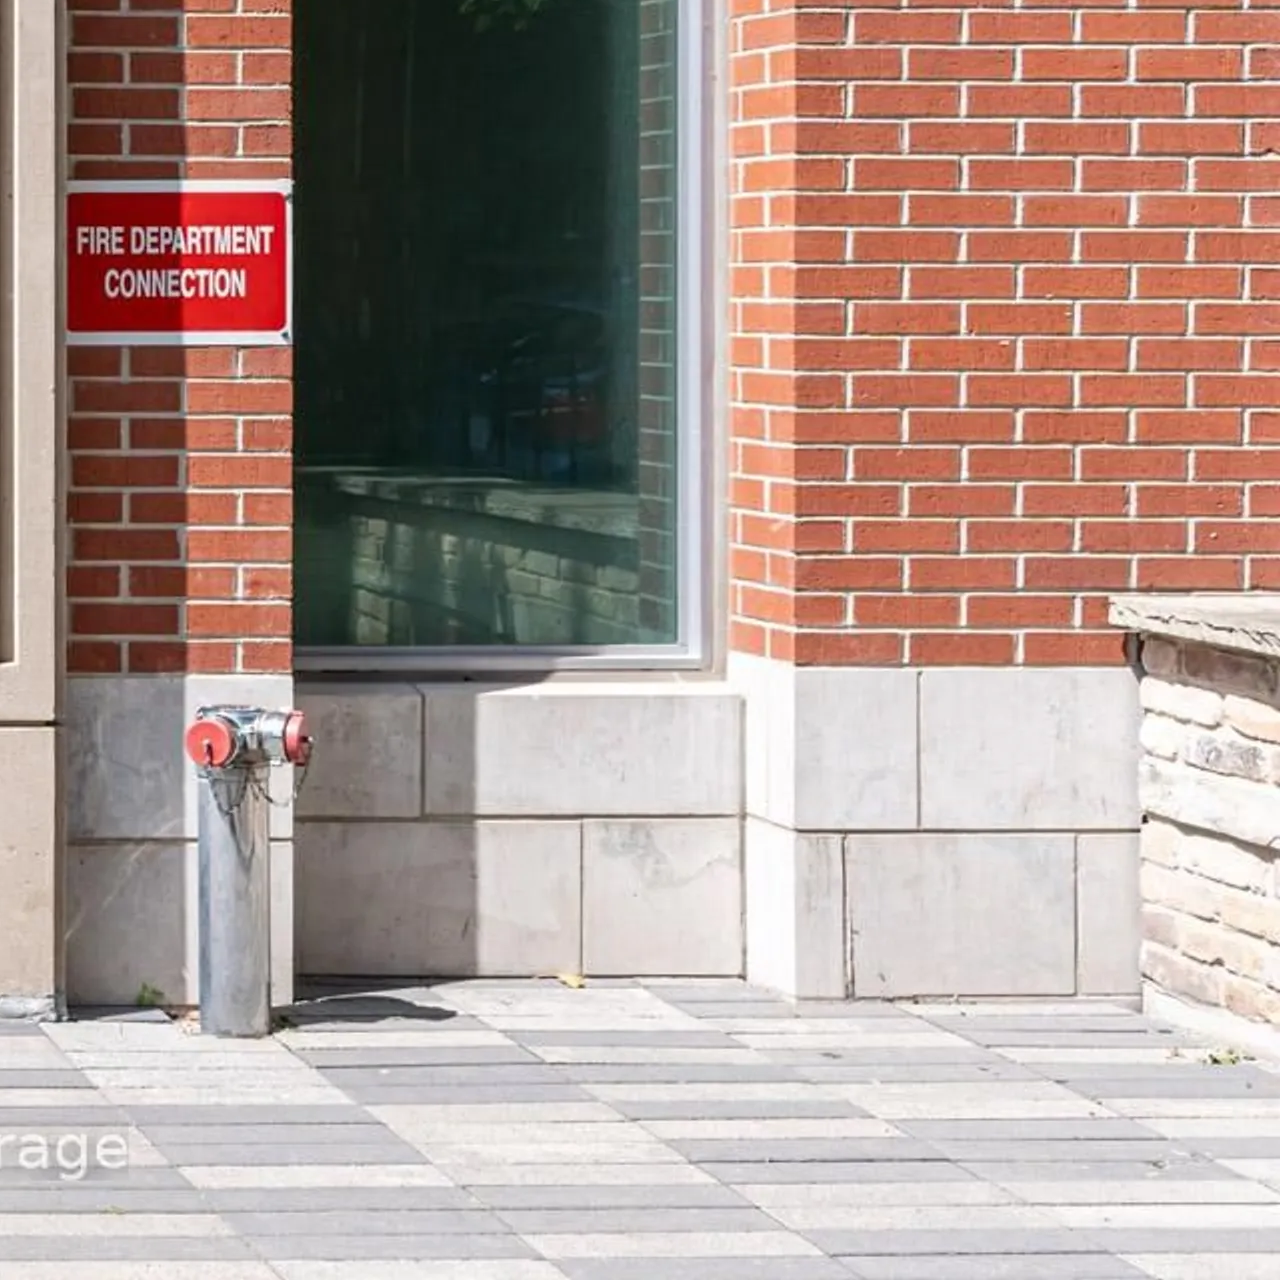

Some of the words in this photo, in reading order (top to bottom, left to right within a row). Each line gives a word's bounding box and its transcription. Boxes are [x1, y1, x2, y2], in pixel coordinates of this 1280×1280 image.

[76, 226, 125, 255] FIRE
[130, 226, 274, 255] DEPARTMENT
[104, 268, 247, 298] CONNECTION
